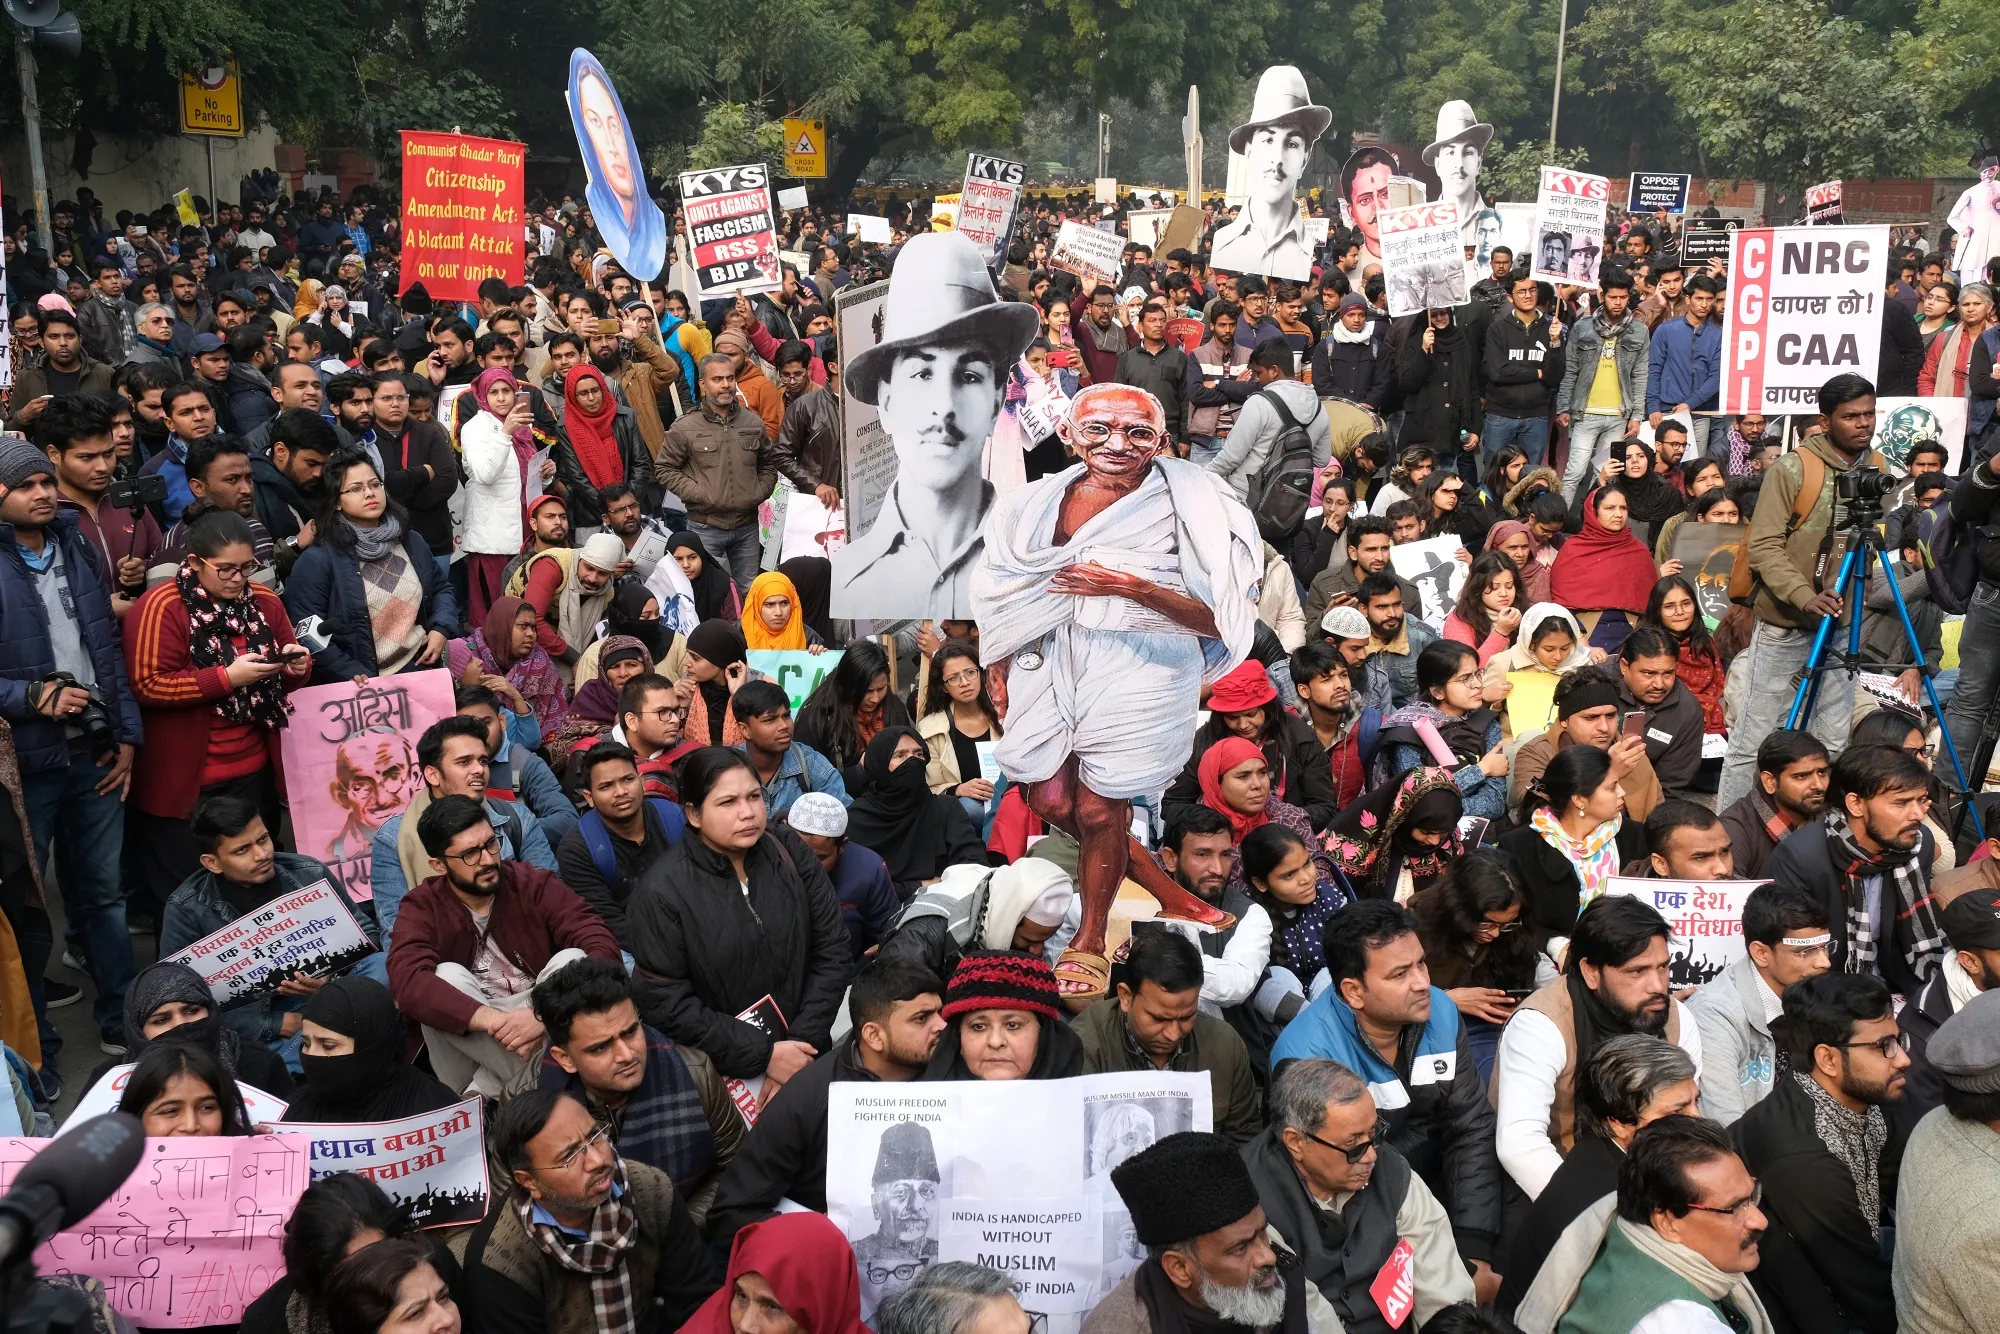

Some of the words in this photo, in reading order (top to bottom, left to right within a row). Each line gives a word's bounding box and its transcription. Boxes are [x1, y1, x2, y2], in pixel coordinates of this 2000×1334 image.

[204, 97, 218, 110] No
[195, 109, 232, 126] Parking
[406, 141, 458, 158] Communist
[460, 143, 495, 162] Ghadar
[497, 149, 521, 169] Party
[683, 166, 765, 197] KYS
[974, 156, 1024, 184] KYS
[1641, 176, 1679, 186] OPPOSE
[425, 167, 506, 198] Citizenship
[967, 179, 1014, 202] सांप्रदायिकता
[1545, 171, 1607, 200] KYS
[689, 200, 720, 223] UNITE
[720, 192, 766, 216] AGAINST
[1550, 195, 1571, 206] साझी
[1641, 193, 1677, 201] PROTECT
[1807, 185, 1841, 207] KYS
[407, 196, 487, 221] Amendment
[492, 203, 518, 224] Act:
[963, 200, 986, 220] फैलाने
[986, 205, 1003, 224] वाले
[1381, 204, 1457, 233] KYS
[1548, 207, 1570, 219] साझी
[695, 213, 767, 244] FASCISM
[985, 228, 996, 246] को
[1542, 221, 1563, 232] साझी
[405, 228, 415, 248] A
[418, 229, 465, 250] blatant
[469, 233, 514, 255] Attak
[714, 238, 760, 261] RSS
[1781, 240, 1870, 275] NRC
[418, 262, 434, 278] on
[438, 262, 460, 279] our
[463, 264, 507, 281] unity
[709, 261, 750, 284] BJP
[1771, 296, 1831, 315] वापस
[1736, 237, 1766, 415] CGPI
[1508, 349, 1545, 362] PUMA
[1776, 333, 1860, 366] CAA
[1815, 553, 1827, 577] Canon
[320, 687, 413, 744] अहिंसा
[1653, 890, 1688, 910] एक
[1692, 885, 1732, 912] देश,
[190, 925, 250, 960] विरासत,
[252, 909, 275, 927] एक
[275, 887, 329, 914] शहादत,
[216, 946, 239, 963] एक
[239, 916, 301, 951] शहरियत,
[252, 946, 265, 960] में
[265, 938, 286, 960] हर
[286, 915, 337, 944] नागरिक
[228, 975, 247, 990] की
[247, 963, 271, 982] एक
[271, 936, 327, 969] अहमियत
[855, 1098, 896, 1107] MUSLIM
[899, 1098, 947, 1108] FREEDOM
[1083, 1094, 1109, 1103] MUSLIM
[1109, 1091, 1136, 1100] MISSILE
[1137, 1090, 1156, 1098] MAN
[1168, 1090, 1189, 1098] INDIA
[854, 1112, 896, 1122] FIGHTER
[898, 1113, 911, 1122] OF
[914, 1113, 942, 1122] INDIA
[382, 1110, 472, 1152] बचाओ
[952, 1211, 985, 1223] INDIA
[988, 1214, 998, 1223] IS
[1001, 1212, 1082, 1224] HANDICAPPED
[81, 1211, 151, 1261] कहते
[163, 1206, 195, 1255] हो,
[982, 1230, 1052, 1243] WITHOUT
[977, 1253, 1056, 1271] MUSLIM
[1036, 1281, 1076, 1295] INDIA
